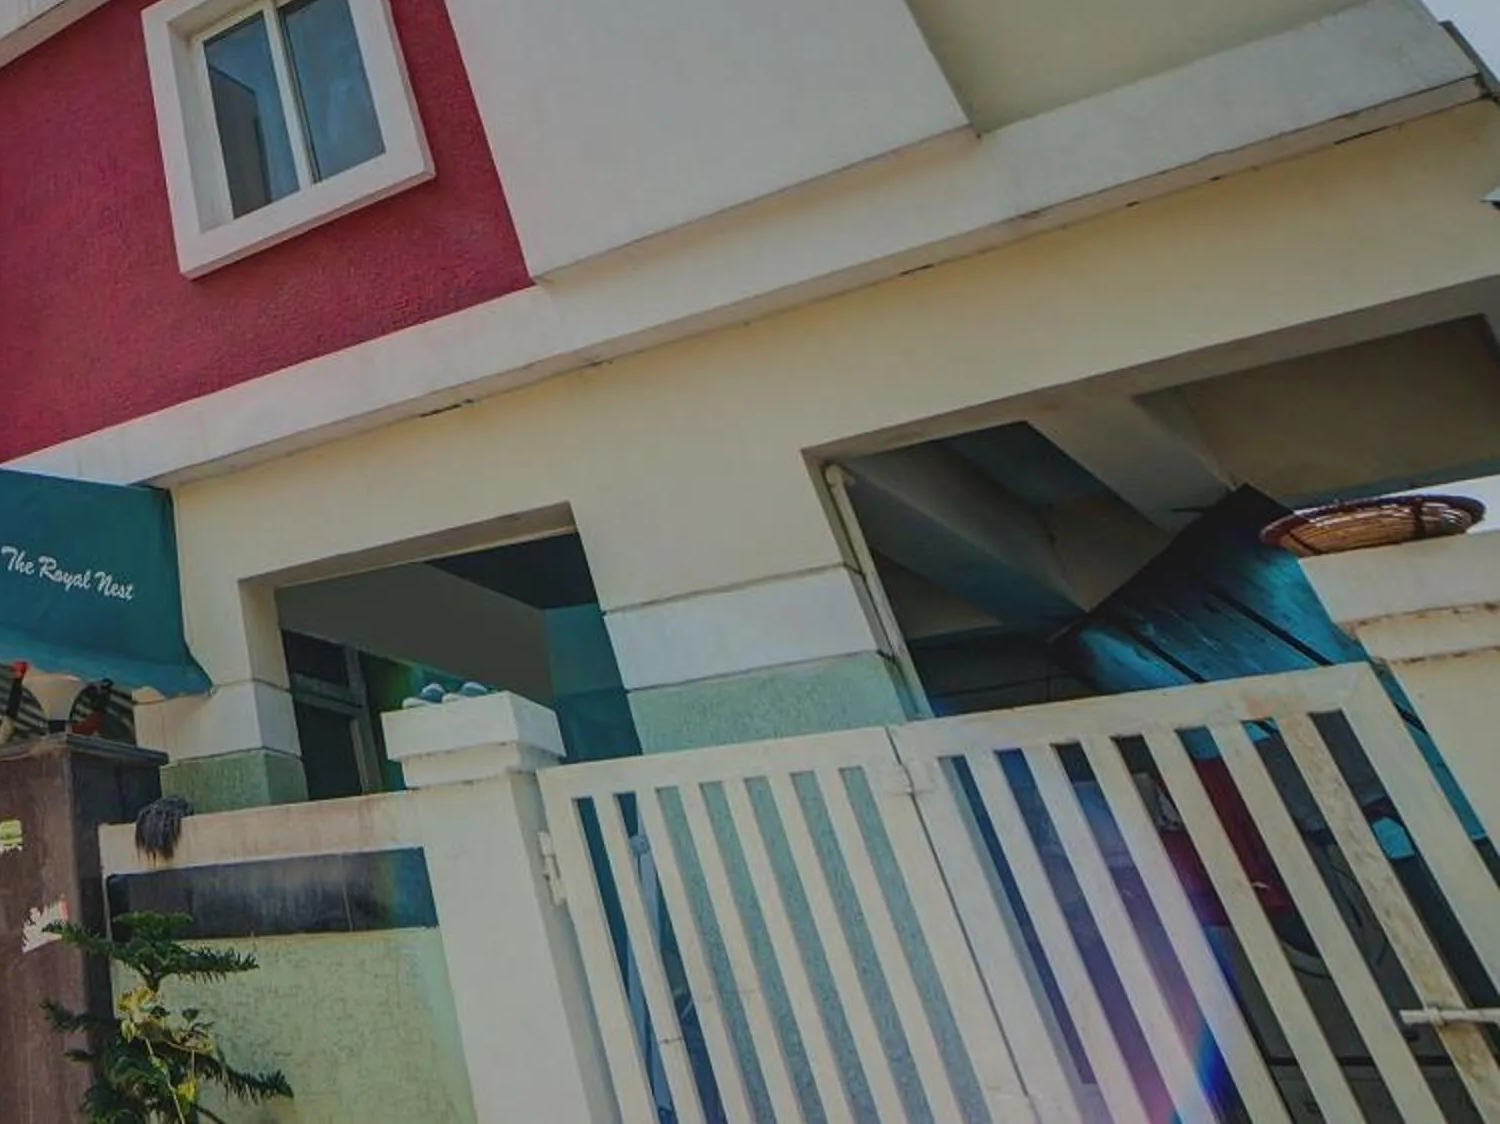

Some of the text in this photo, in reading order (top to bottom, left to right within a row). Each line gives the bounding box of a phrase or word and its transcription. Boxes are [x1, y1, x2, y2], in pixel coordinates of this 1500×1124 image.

[1, 545, 35, 575] The
[38, 555, 91, 592] Royal
[94, 571, 134, 600] Nest
